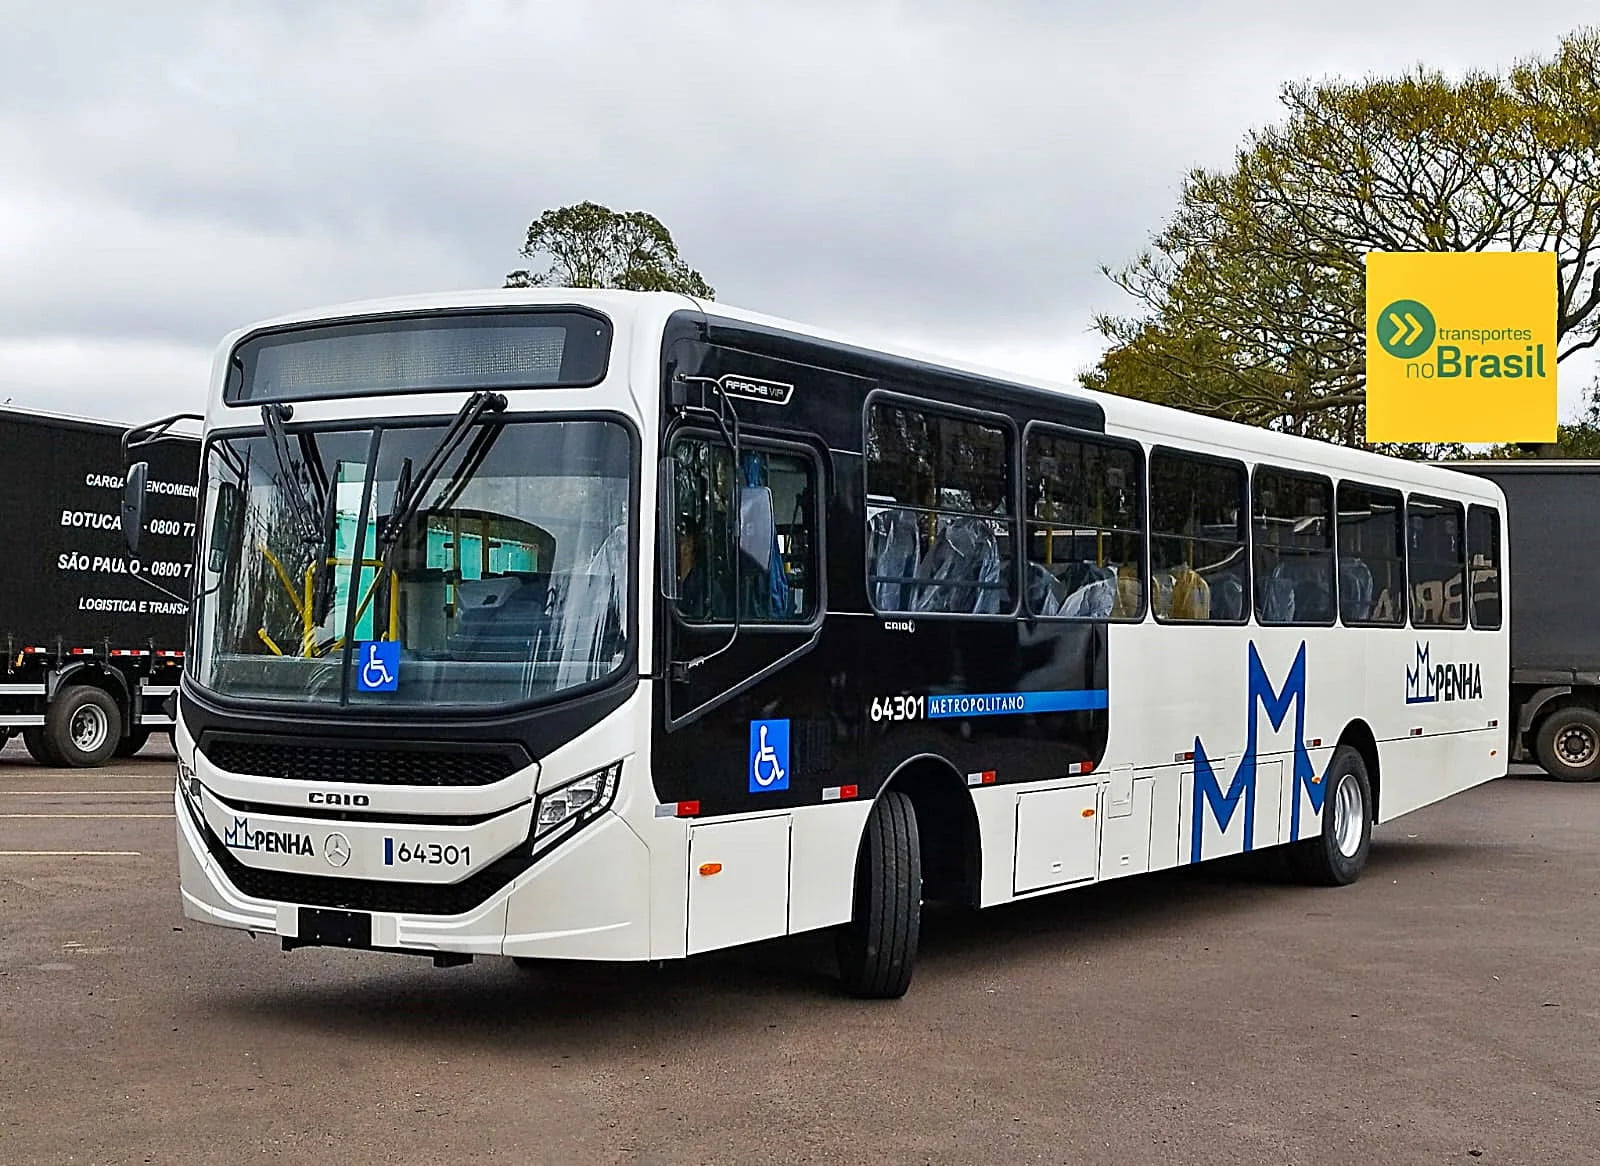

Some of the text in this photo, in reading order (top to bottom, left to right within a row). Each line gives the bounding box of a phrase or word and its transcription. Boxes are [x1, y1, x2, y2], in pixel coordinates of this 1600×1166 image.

[86, 474, 198, 497] CARGA ENCOMEN
[61, 511, 122, 530] BOTUCA
[150, 519, 180, 535] 0800
[183, 523, 196, 537] 77
[58, 552, 90, 571] SÃO
[92, 557, 141, 575] PAULO
[151, 561, 181, 578] 0800
[183, 563, 193, 578] 7
[79, 597, 137, 612] LOGISTICA
[139, 601, 147, 613] E
[1436, 663, 1482, 702] PENHA
[870, 696, 1025, 722] 64301 METROPOLITANO
[308, 792, 370, 806] CAIO
[255, 831, 315, 856] PENHA
[398, 843, 471, 866] 64301
